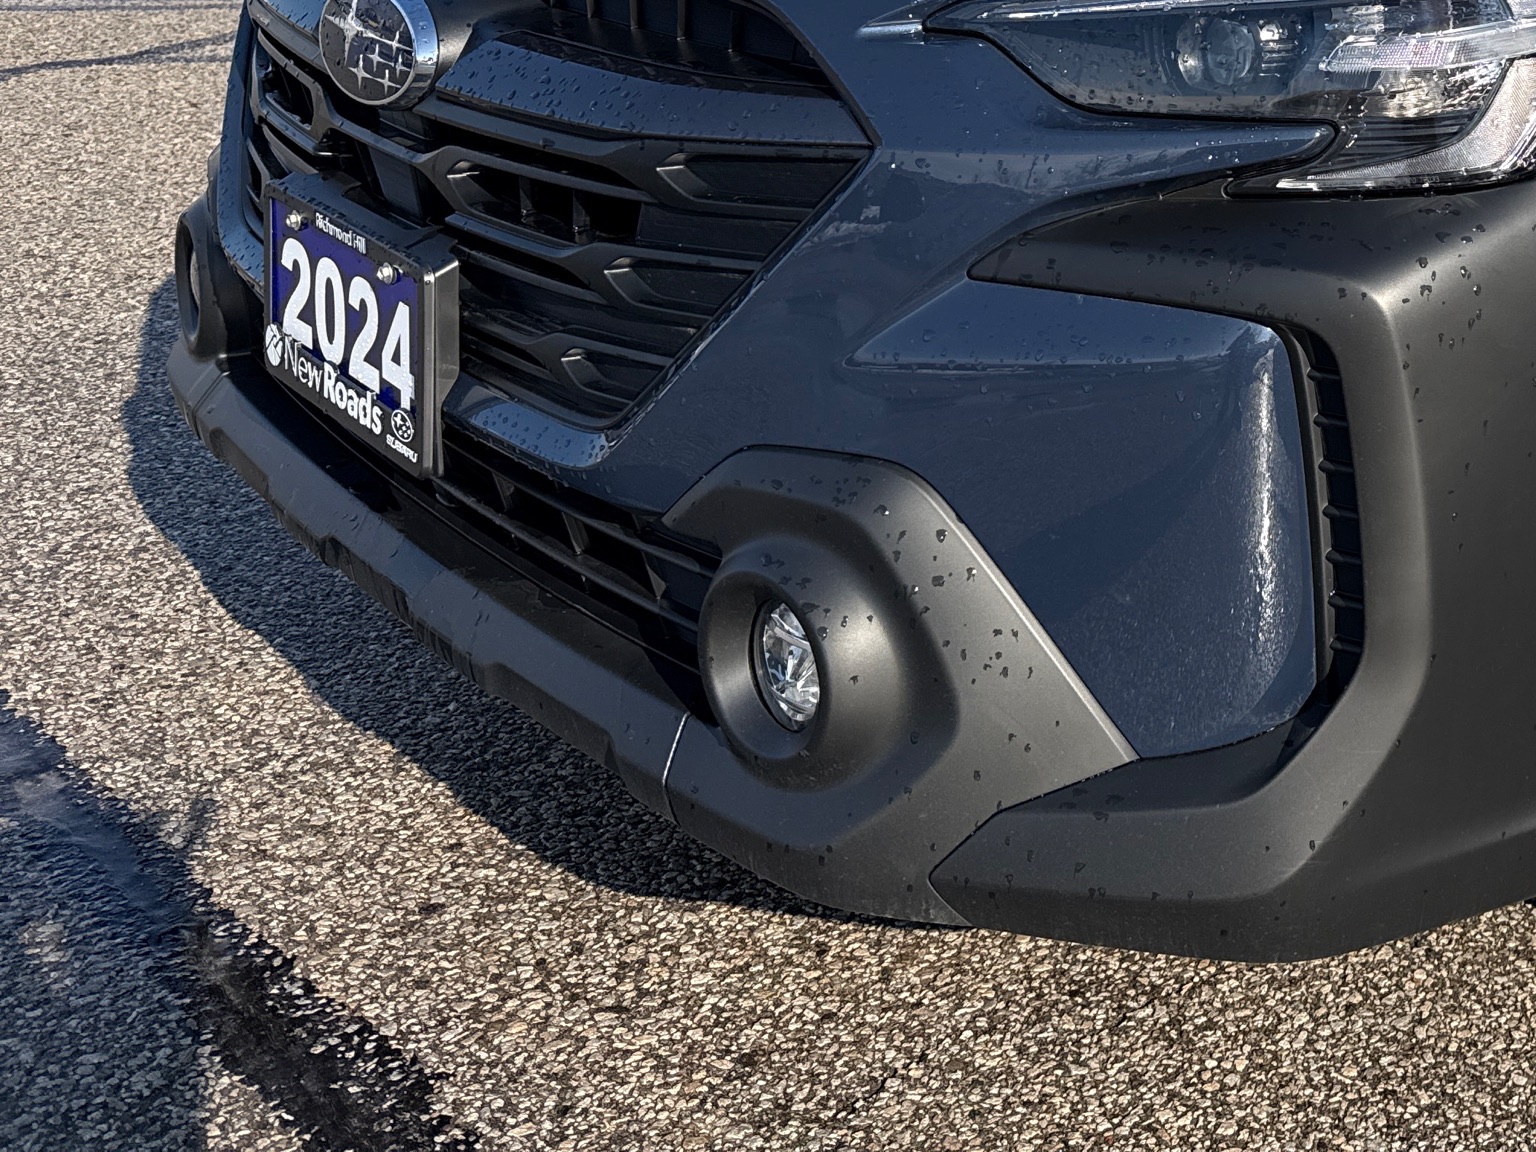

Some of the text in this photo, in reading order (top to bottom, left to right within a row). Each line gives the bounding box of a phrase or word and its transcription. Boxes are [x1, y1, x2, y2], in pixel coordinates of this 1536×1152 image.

[315, 212, 367, 254] Richmond Hill
[281, 237, 417, 411] 2024
[386, 433, 419, 463] SUBARU
